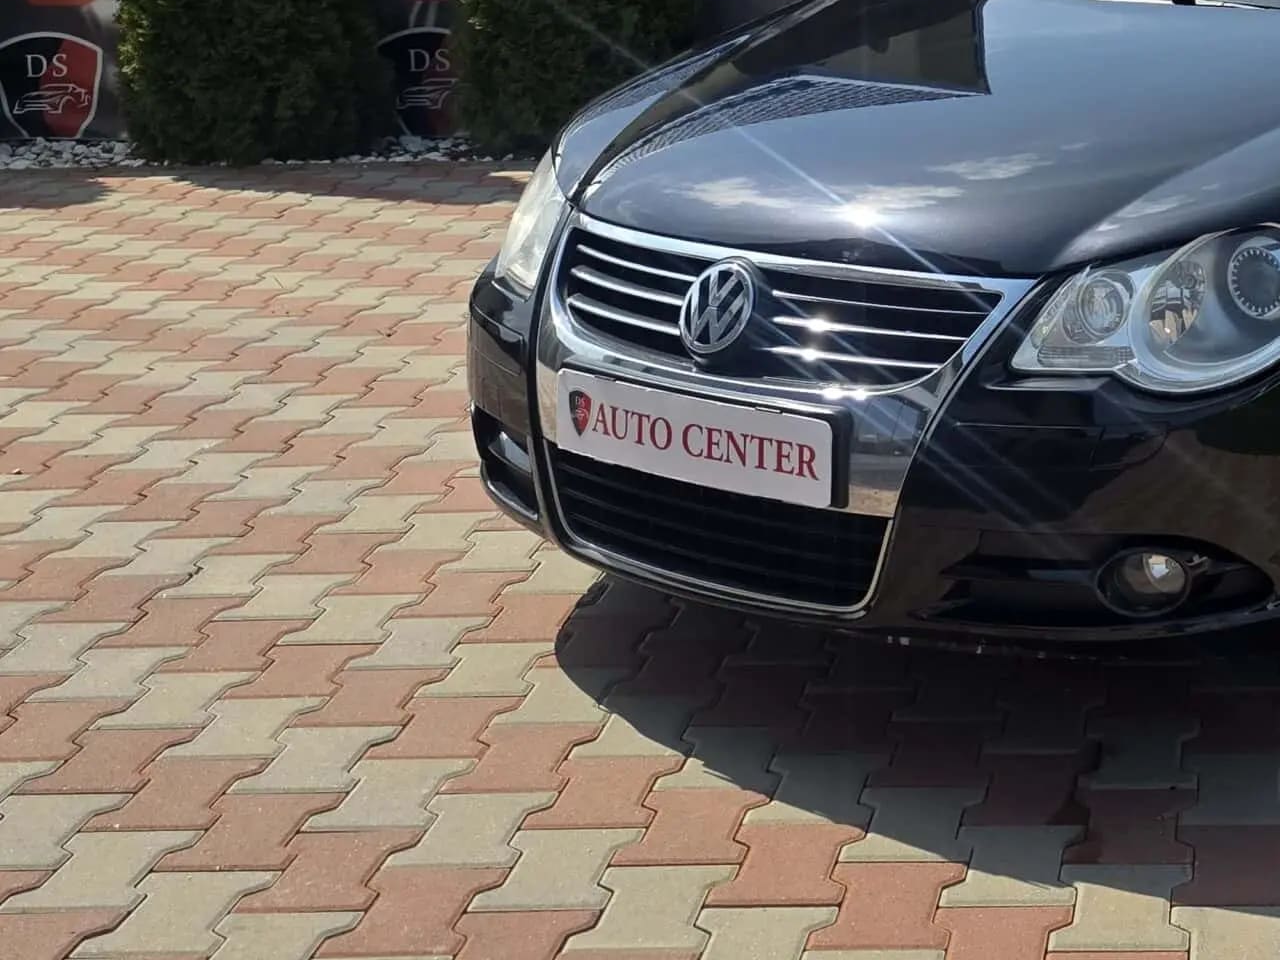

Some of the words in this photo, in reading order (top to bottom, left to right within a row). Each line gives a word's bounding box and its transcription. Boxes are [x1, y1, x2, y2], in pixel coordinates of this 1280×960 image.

[25, 52, 69, 79] DS
[591, 403, 673, 451] AUTO
[682, 423, 820, 481] CENTER
